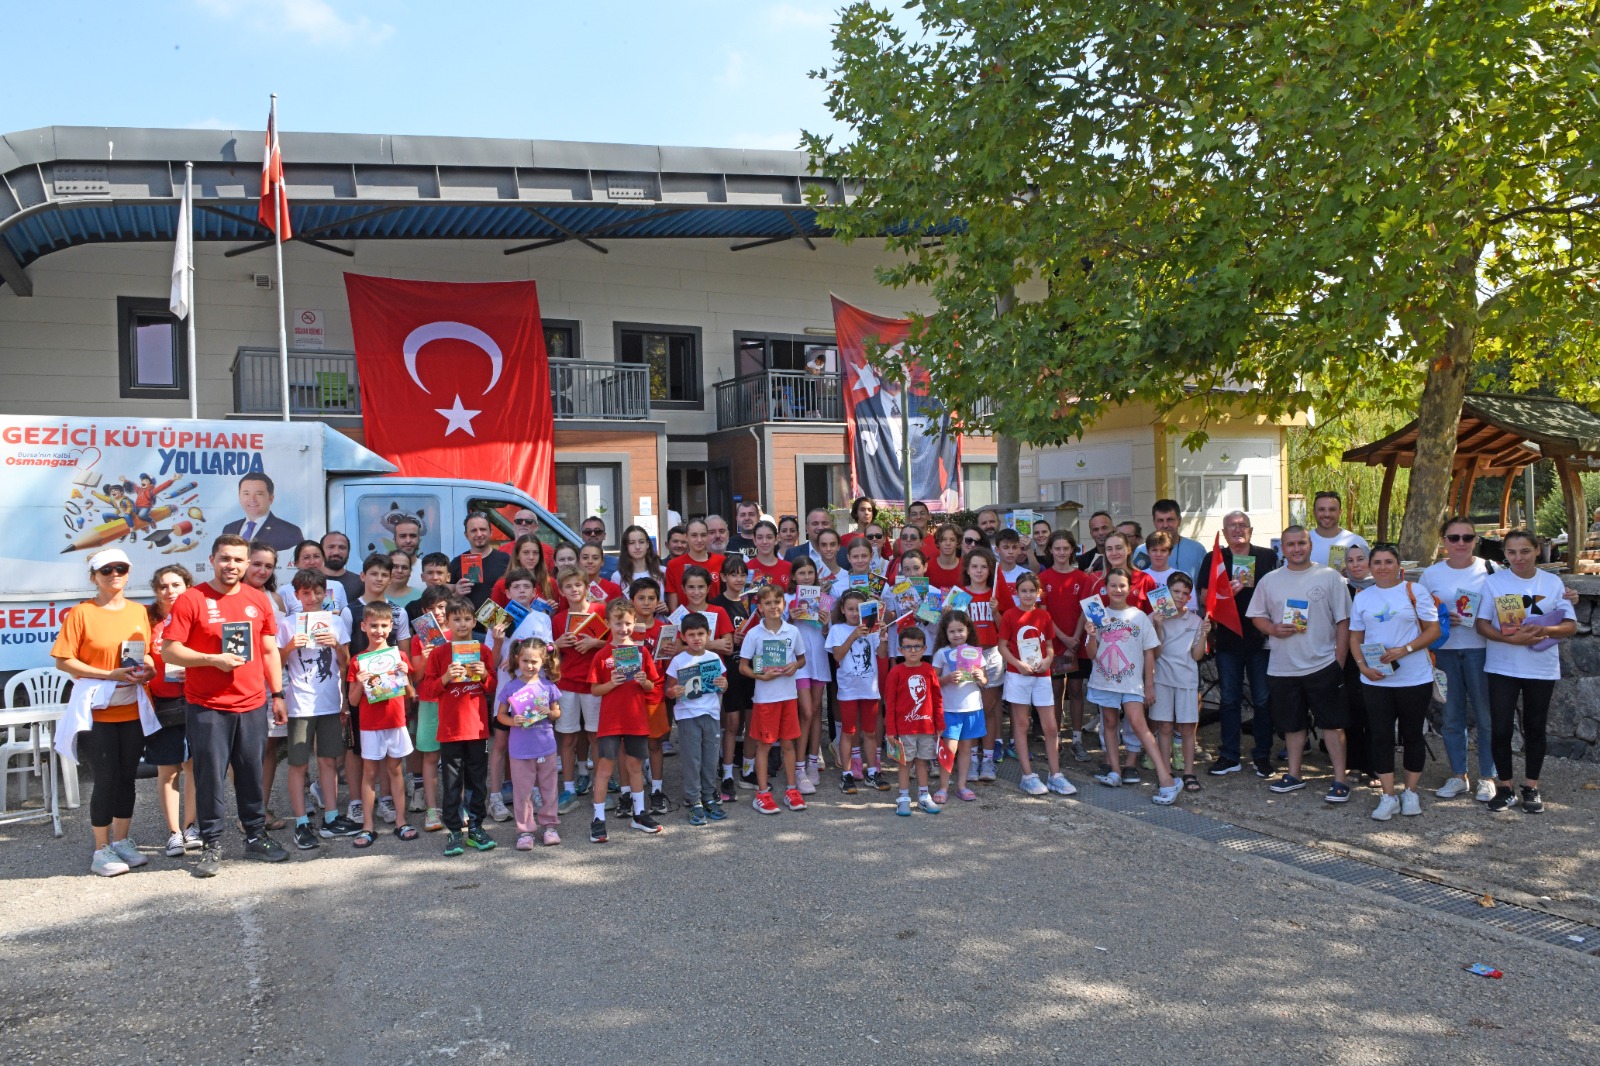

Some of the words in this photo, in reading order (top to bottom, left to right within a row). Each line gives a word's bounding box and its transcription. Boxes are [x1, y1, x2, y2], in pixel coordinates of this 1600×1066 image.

[2, 423, 97, 446] GEZİCİ
[104, 425, 264, 449] KÜTÜPHANE
[5, 457, 79, 468] Osmangazi
[158, 448, 264, 476] YOLLARDA
[0, 601, 73, 629] EZİC
